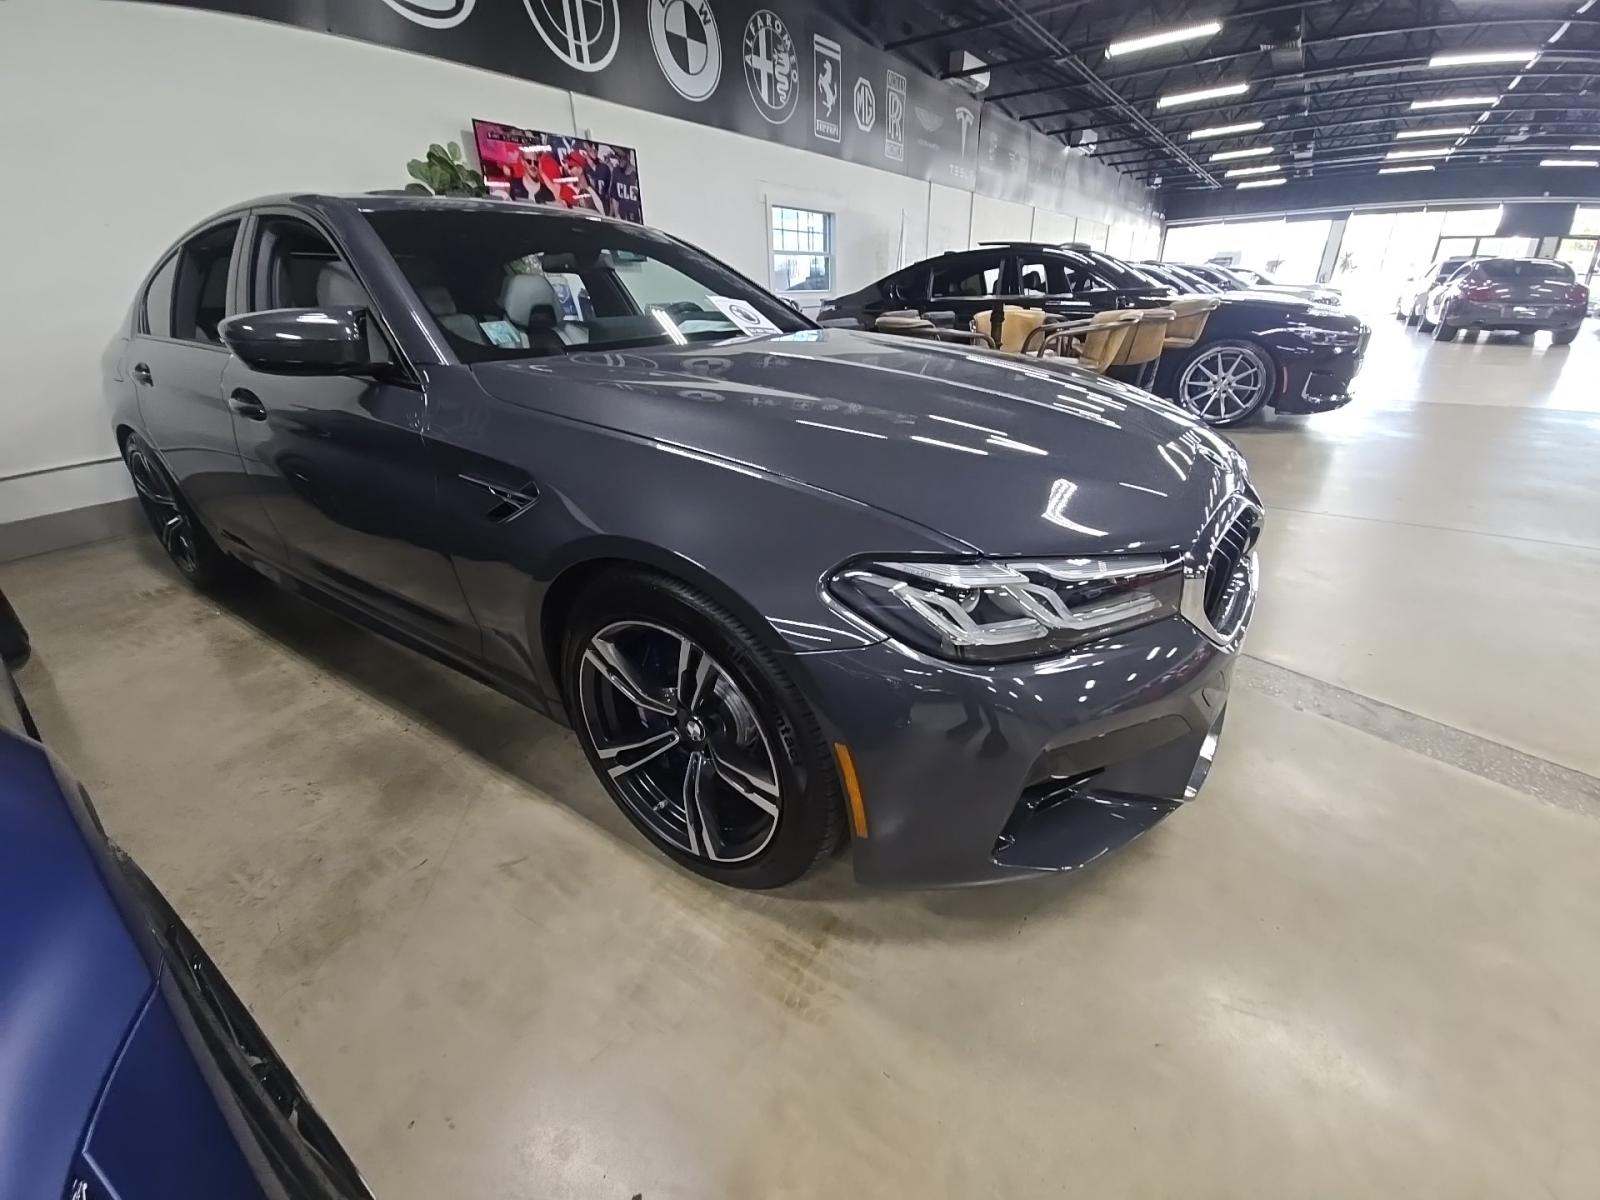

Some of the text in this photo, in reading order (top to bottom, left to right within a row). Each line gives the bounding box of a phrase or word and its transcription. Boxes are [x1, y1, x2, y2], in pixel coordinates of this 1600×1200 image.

[744, 15, 765, 68] ALFA
[765, 14, 799, 84] ROMEO
[856, 84, 873, 125] MG
[816, 119, 839, 138] Ferrari
